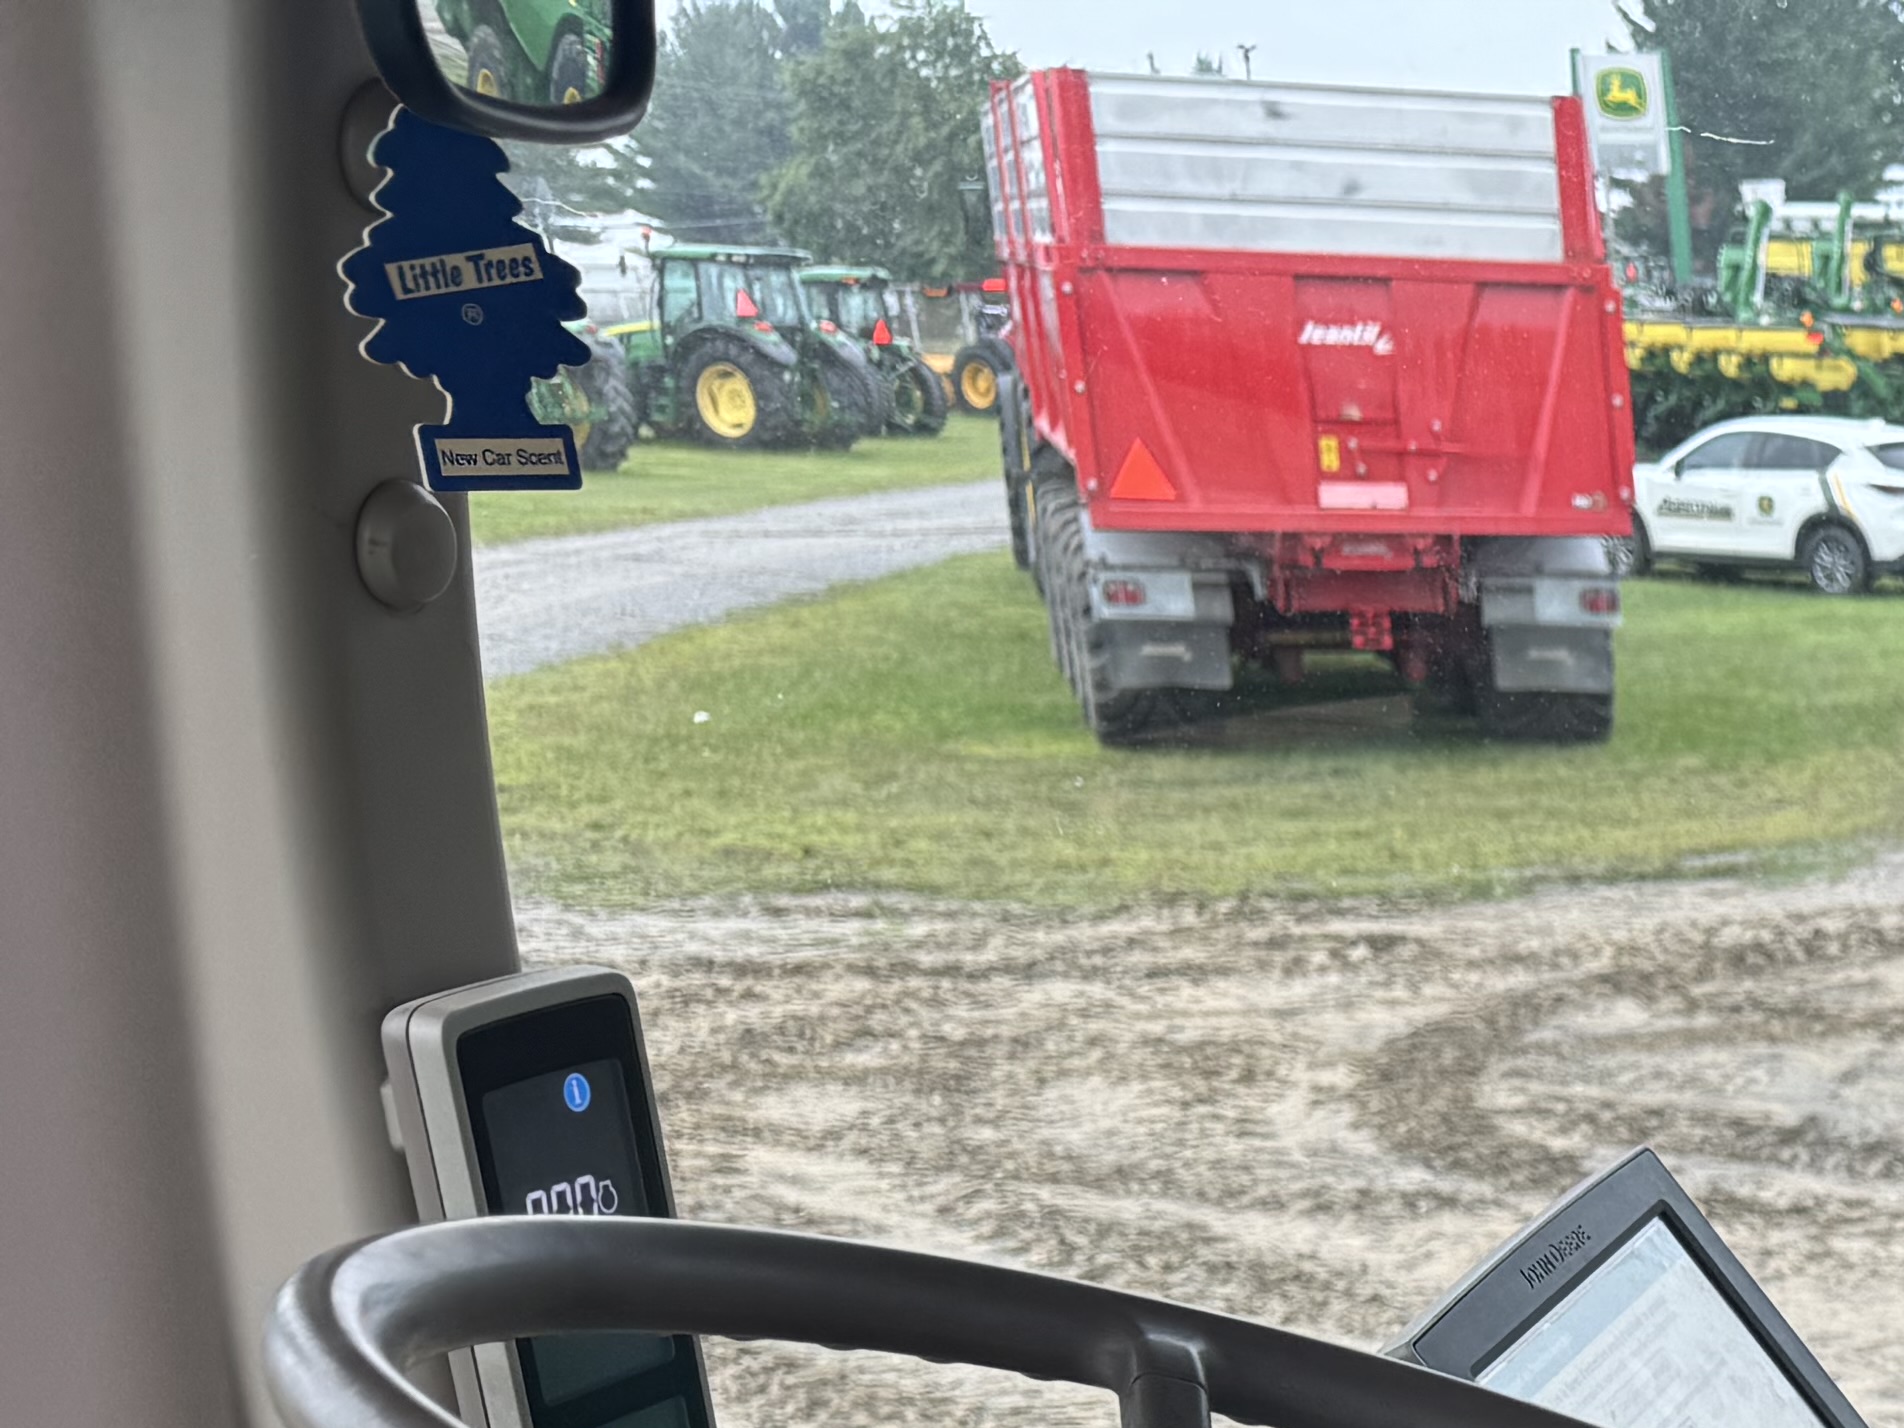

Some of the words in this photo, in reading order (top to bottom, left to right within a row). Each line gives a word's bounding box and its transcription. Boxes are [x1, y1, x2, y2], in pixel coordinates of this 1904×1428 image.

[397, 258, 463, 296] Little
[465, 252, 535, 284] Trees
[441, 449, 478, 466] New
[482, 449, 512, 466] Car
[516, 449, 565, 466] Scent
